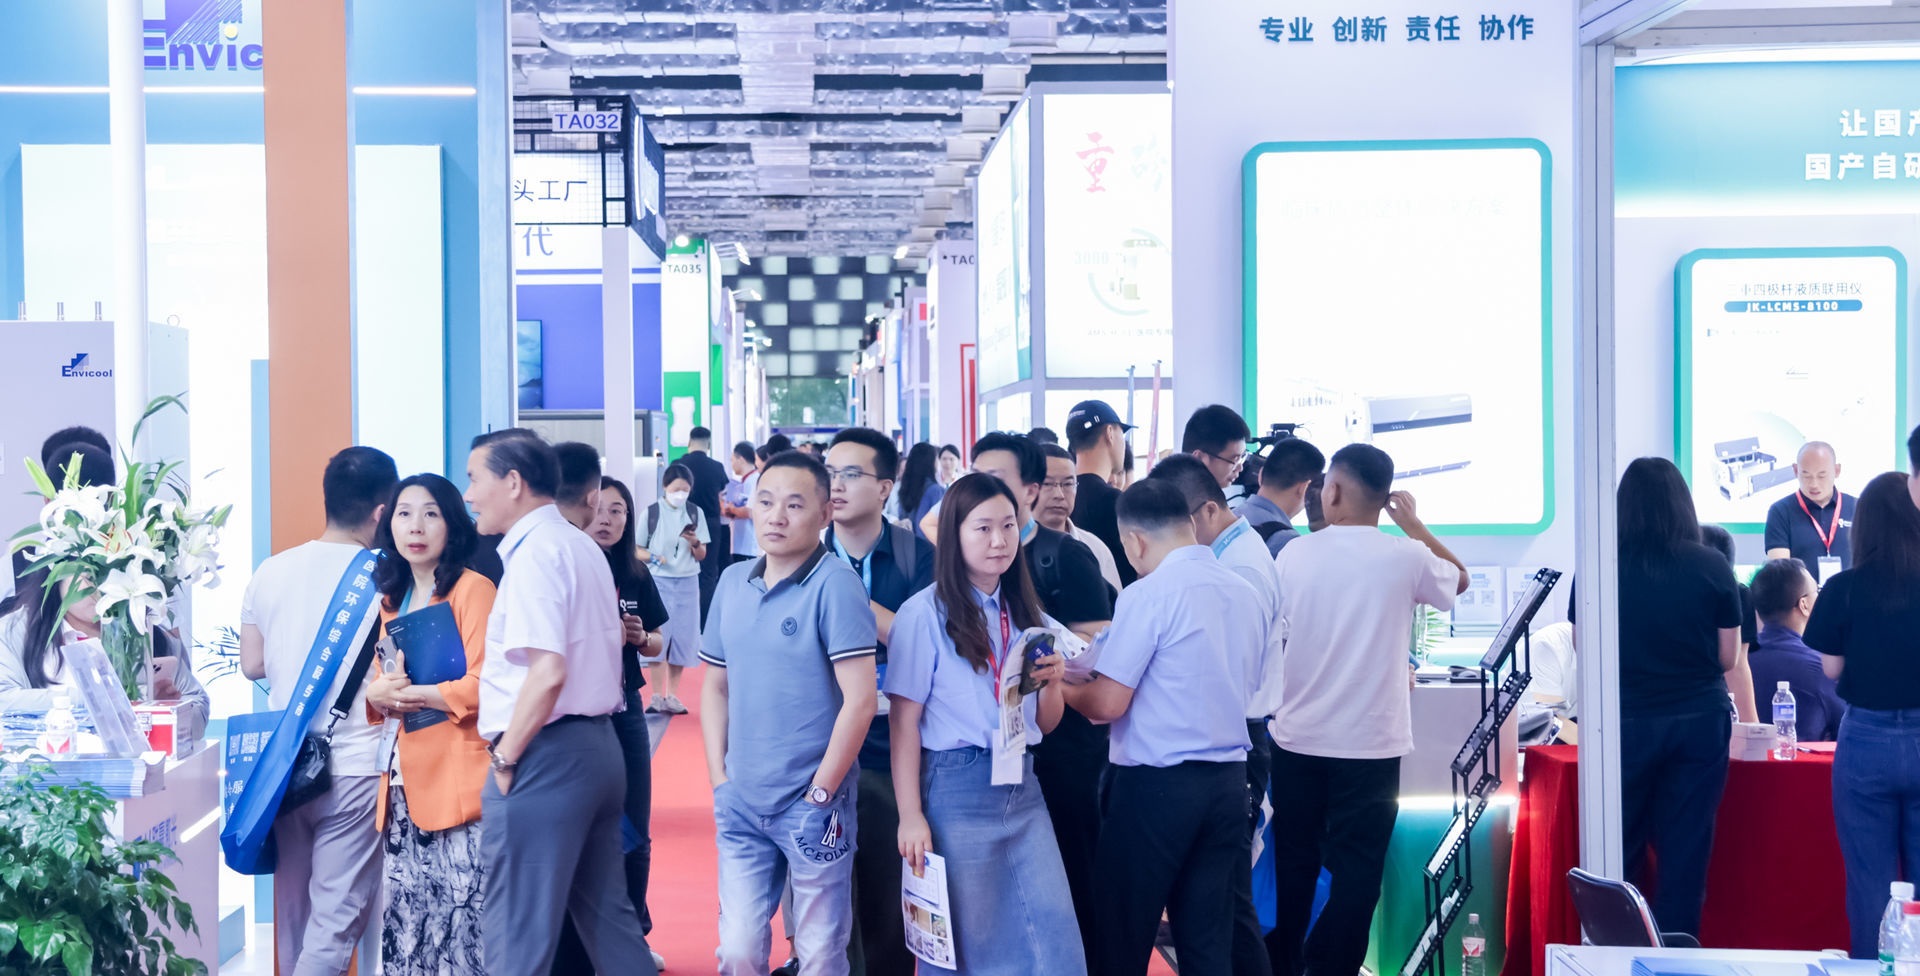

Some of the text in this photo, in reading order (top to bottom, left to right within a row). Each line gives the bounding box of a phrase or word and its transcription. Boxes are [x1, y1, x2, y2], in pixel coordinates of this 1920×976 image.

[1259, 14, 1535, 42] 专业 创新 责任 协作
[554, 113, 619, 129] TA032
[513, 179, 588, 202] 头工厂
[522, 221, 553, 257] 代
[667, 264, 702, 273] TA035
[1746, 302, 1838, 313] JK-LCMS-8100
[62, 365, 112, 377] Envicool
